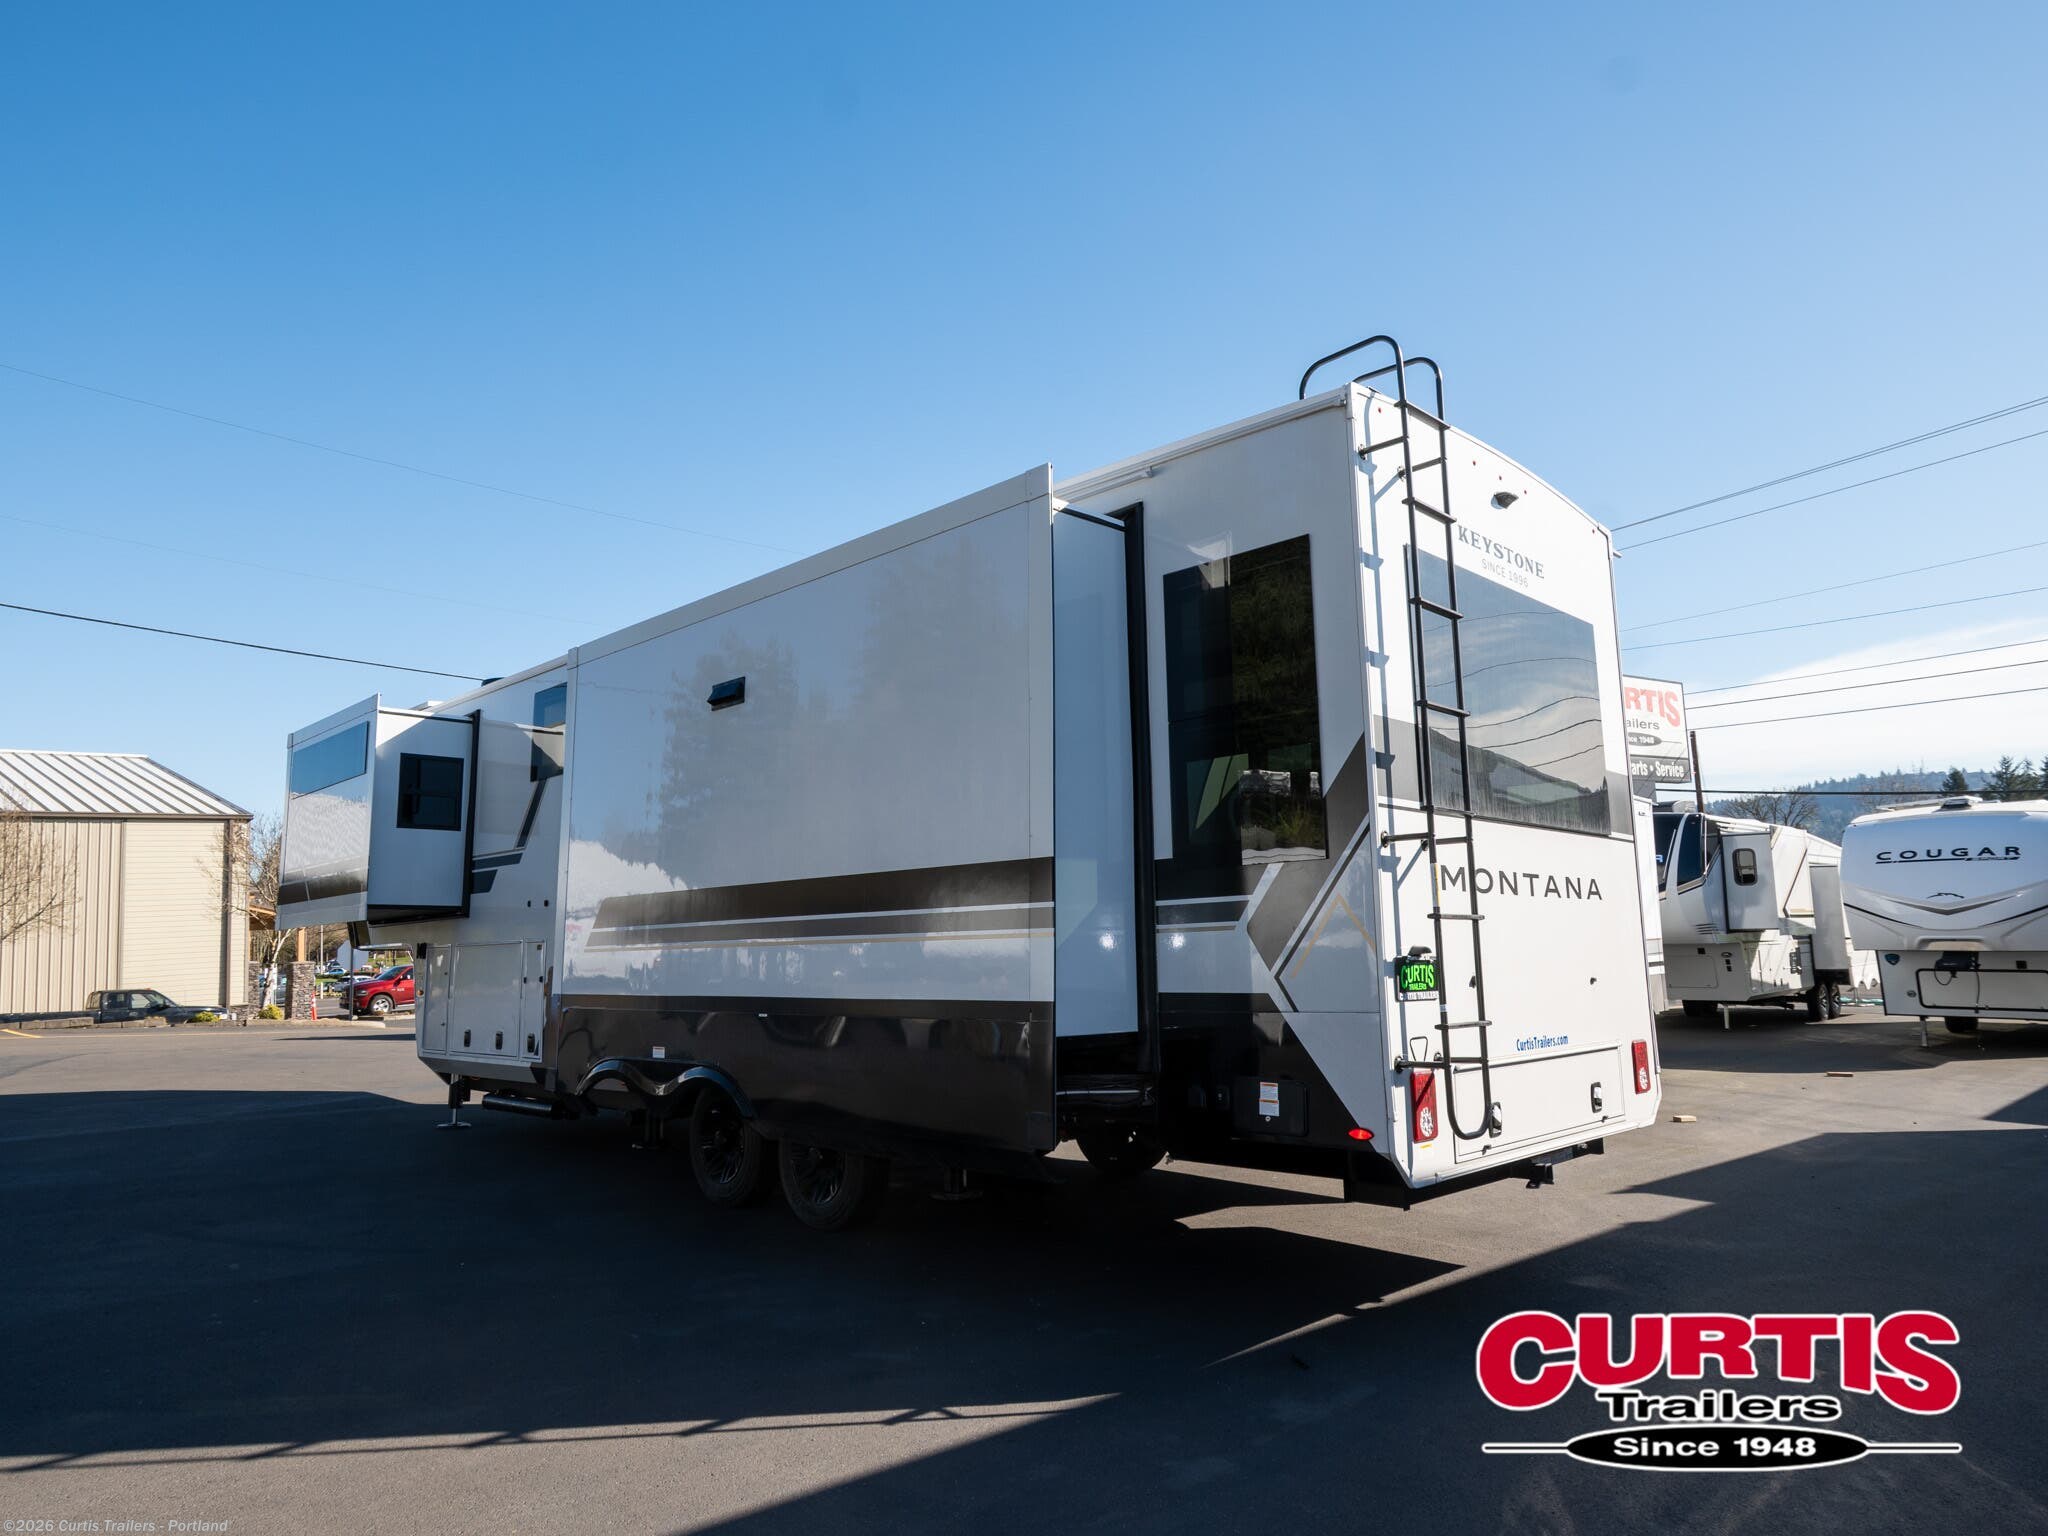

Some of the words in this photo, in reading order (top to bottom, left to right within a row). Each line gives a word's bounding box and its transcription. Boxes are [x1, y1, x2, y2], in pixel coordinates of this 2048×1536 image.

[1457, 524, 1545, 580] KEYSTONE
[1481, 558, 1506, 579] SINCE
[1655, 760, 1685, 778] Service
[1876, 846, 2021, 861] COUGAR
[1440, 864, 1603, 901] MONTANA
[1401, 964, 1435, 989] CURTIS
[1516, 1035, 1569, 1051] CurtisTrailers.com
